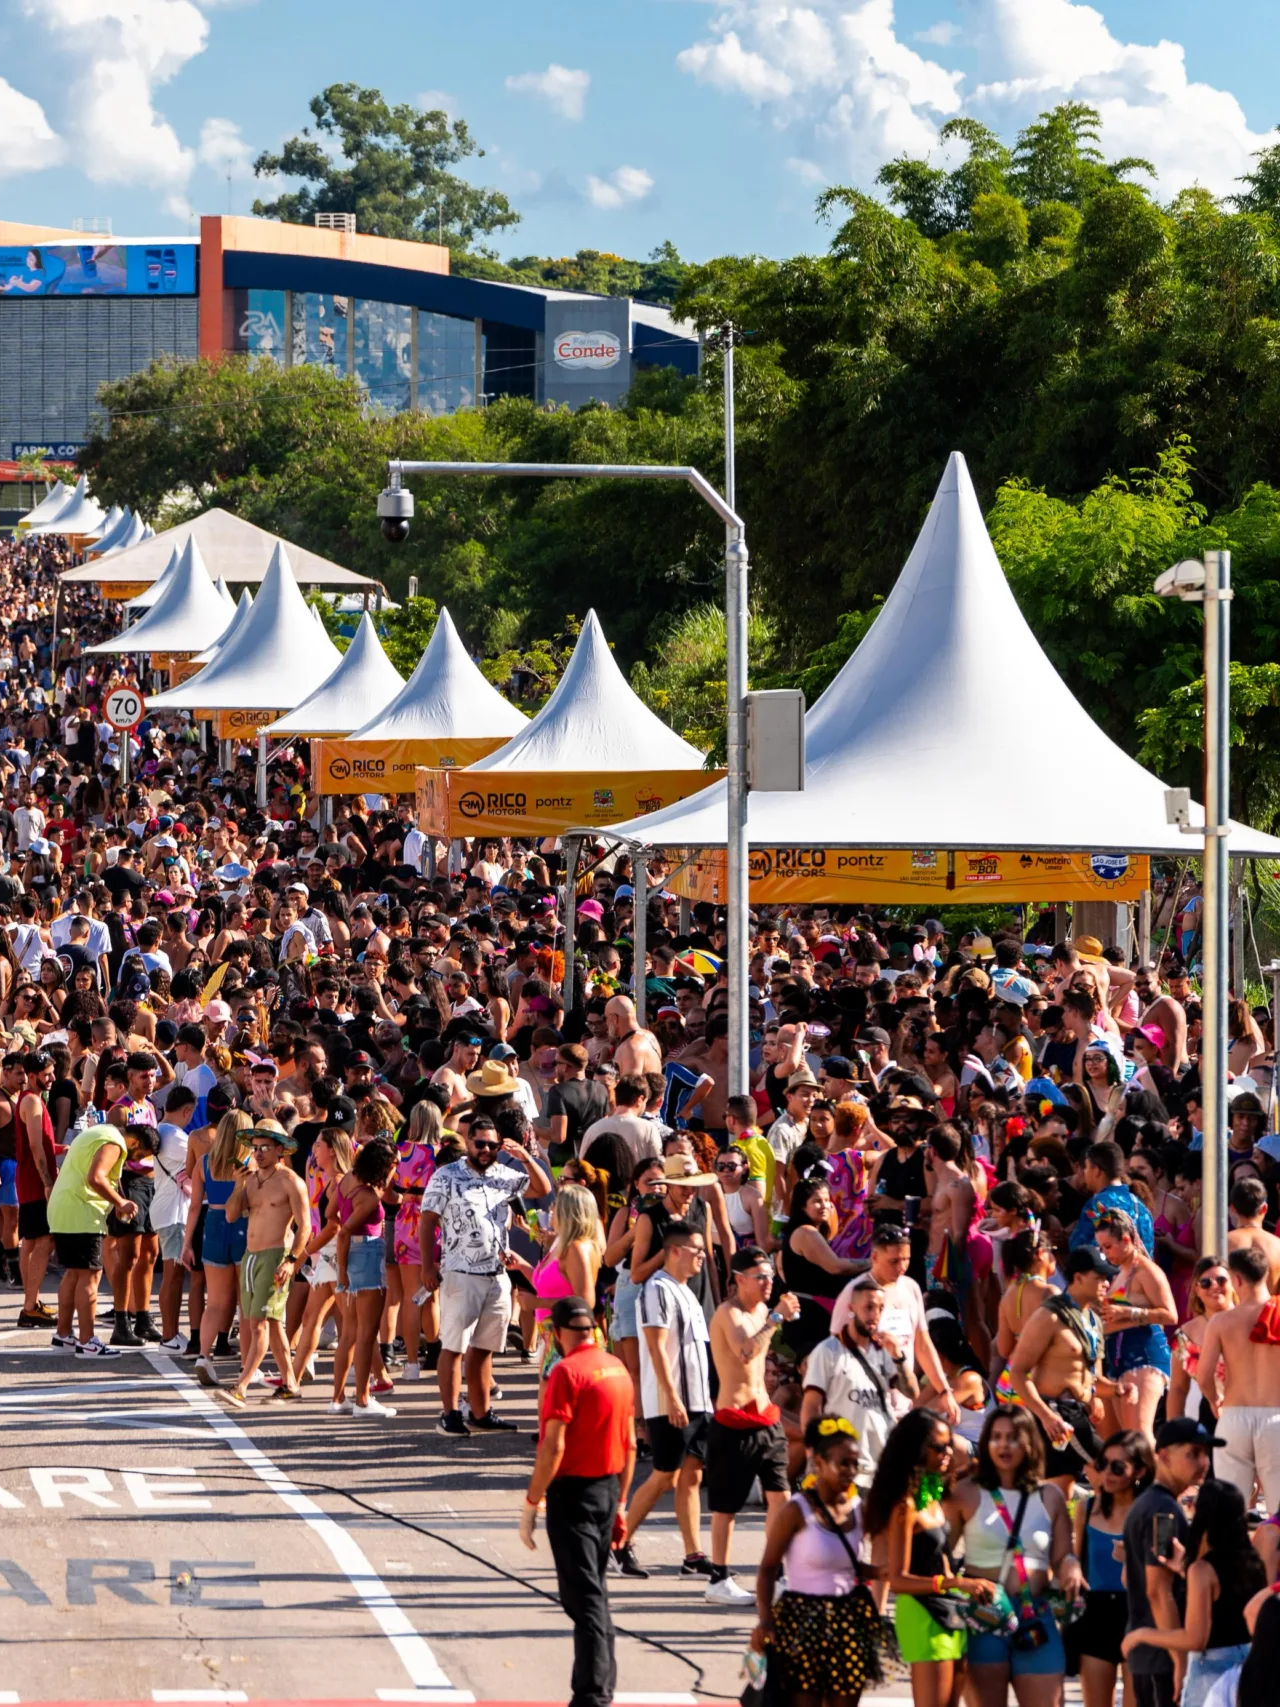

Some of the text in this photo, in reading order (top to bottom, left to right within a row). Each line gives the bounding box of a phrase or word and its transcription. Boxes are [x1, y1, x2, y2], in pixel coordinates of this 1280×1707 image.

[558, 342, 616, 358] Conde
[112, 698, 138, 716] 70
[246, 712, 270, 721] RICO
[353, 760, 385, 772] RICO
[392, 763, 424, 773] pont
[487, 793, 527, 808] RICO
[536, 797, 573, 809] pontz
[487, 808, 527, 816] MOTORS
[775, 849, 826, 867] RICO
[837, 854, 885, 870] pontz
[1035, 856, 1072, 867] Monteiro
[775, 868, 826, 878] MOTORS
[977, 865, 998, 874] BOI
